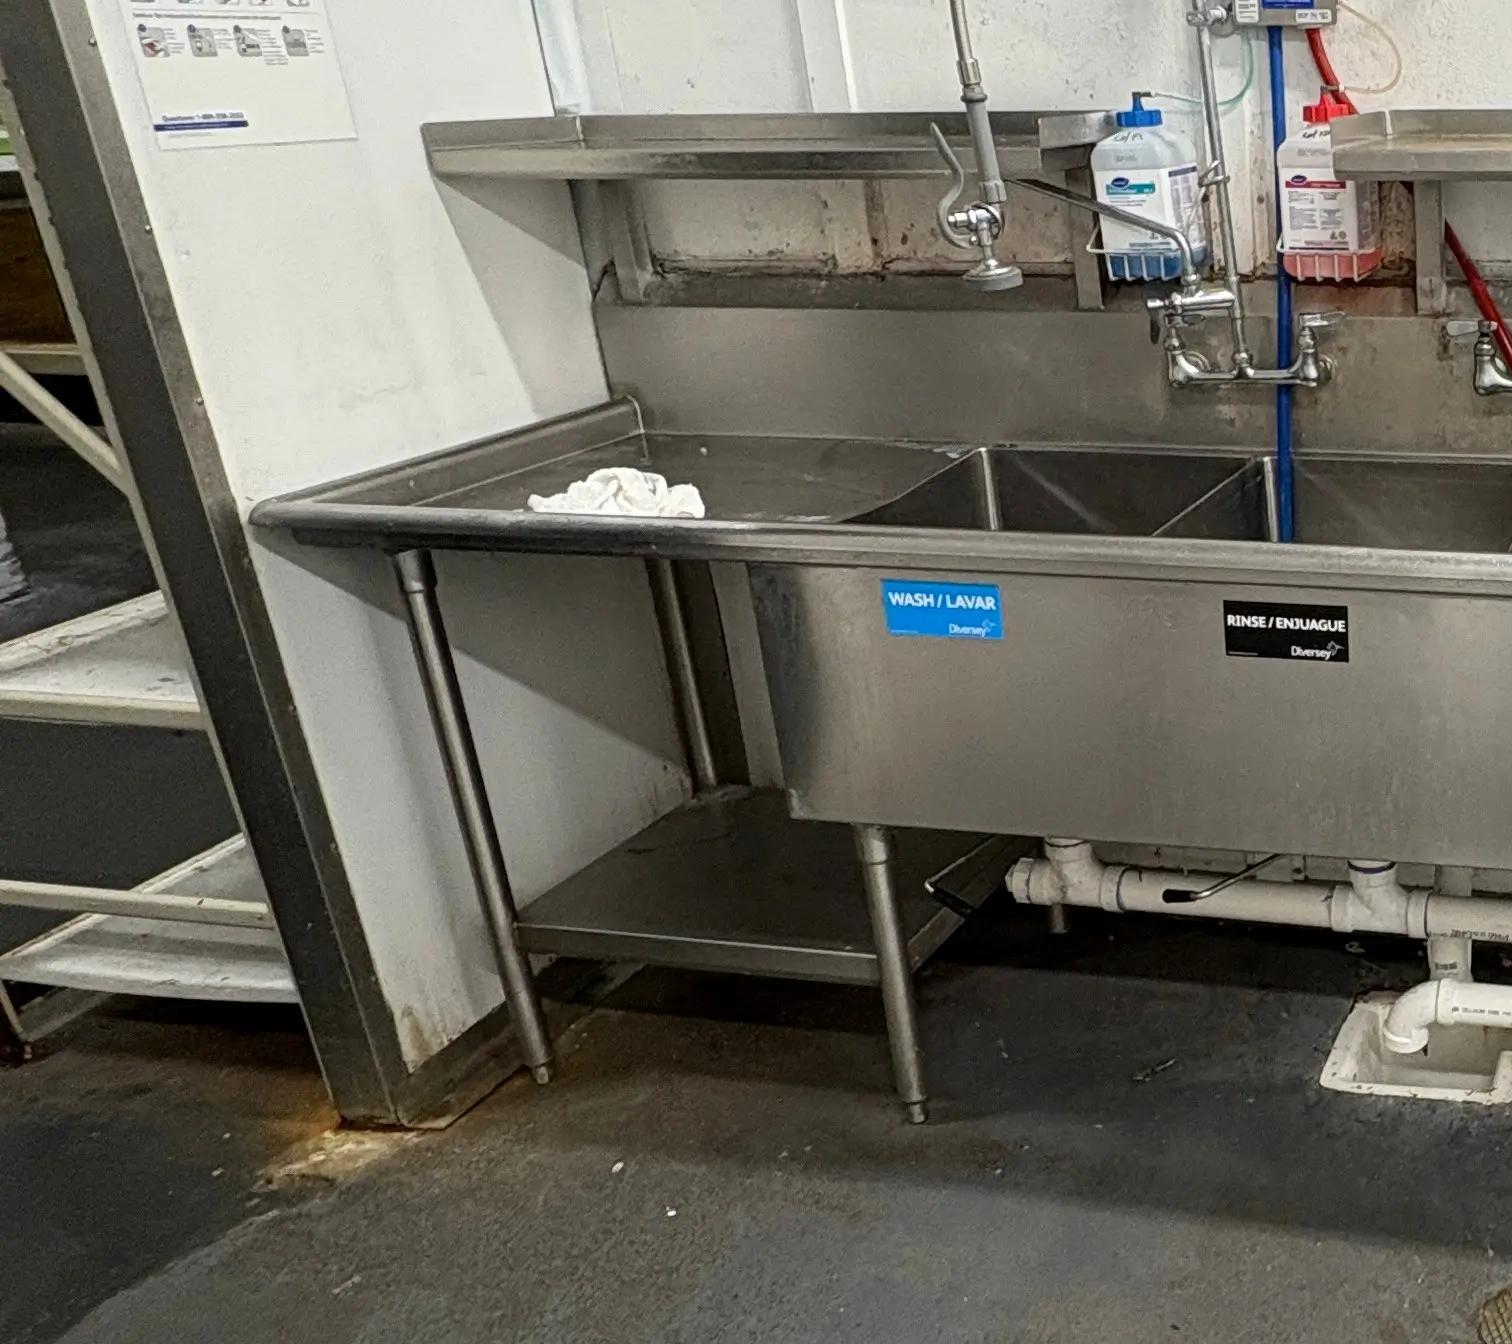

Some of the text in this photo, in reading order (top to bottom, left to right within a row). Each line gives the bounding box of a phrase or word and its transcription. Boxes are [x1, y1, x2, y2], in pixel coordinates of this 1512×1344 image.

[888, 591, 997, 611] WASH / LAVAR
[949, 623, 988, 637] Diversey
[1227, 614, 1346, 632] RINSE / ENJUAGUE
[1291, 645, 1331, 661] Diversey
